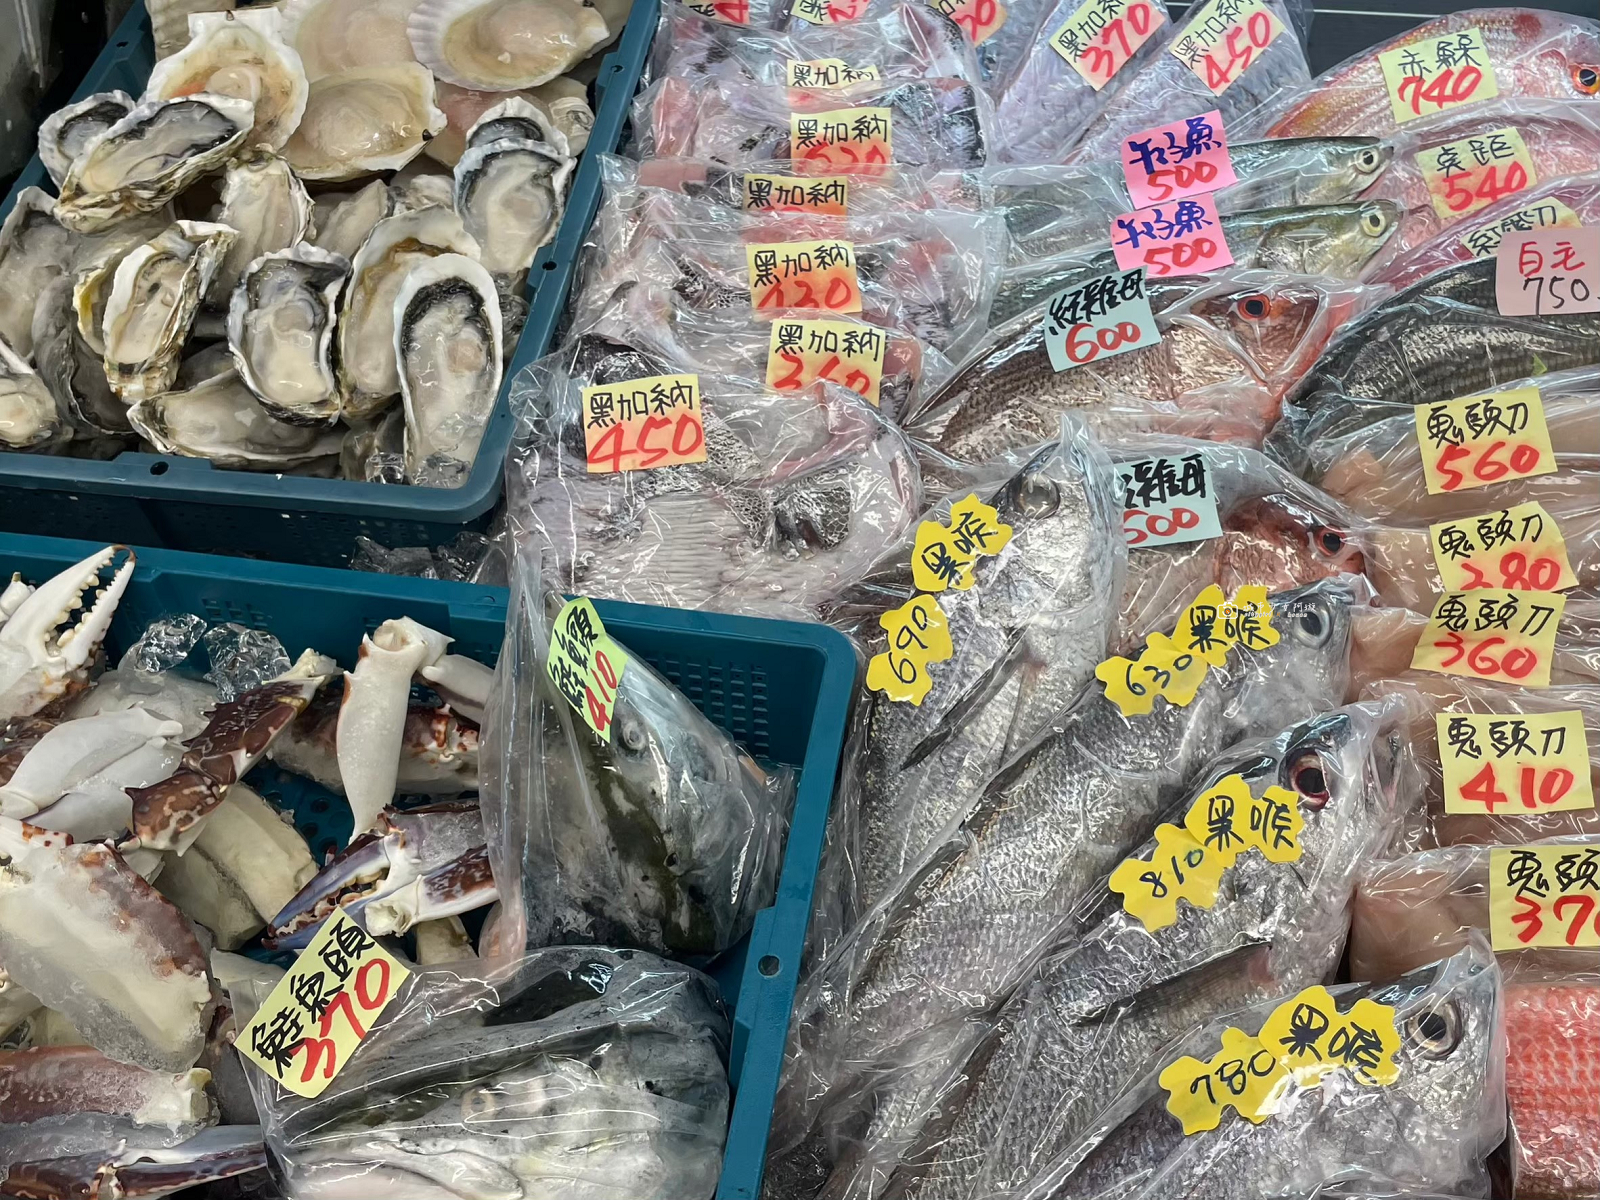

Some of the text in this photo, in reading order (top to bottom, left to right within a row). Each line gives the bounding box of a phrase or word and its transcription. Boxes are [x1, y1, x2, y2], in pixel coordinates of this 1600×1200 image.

[1081, 3, 1150, 77] 370
[1205, 12, 1270, 89] 450
[793, 64, 874, 87] 黑加納
[1398, 65, 1482, 115] 740
[796, 114, 888, 150] 黑加納
[748, 179, 845, 209] 黑加納
[1148, 161, 1218, 201] 500
[1443, 161, 1527, 211] 540
[754, 243, 850, 287] 黑加納
[1143, 238, 1217, 275] 500
[775, 324, 881, 362] 黑加納
[1065, 322, 1141, 363] 600
[587, 381, 693, 429] 黑加納
[1427, 398, 1530, 449] 鬼頭刀
[587, 413, 702, 472] 450
[1436, 441, 1540, 491] 560
[1438, 510, 1544, 560] 鬼頭刀
[1460, 552, 1560, 591] 280
[1436, 593, 1554, 636] 鬼頭刀
[888, 605, 929, 684] 690
[1434, 632, 1538, 679] 360
[585, 650, 618, 731] 410
[1126, 654, 1193, 696] 630
[1447, 717, 1566, 758] 鬼頭刀
[1459, 761, 1574, 813] 410
[1139, 848, 1204, 898] 810
[1511, 894, 1600, 946] 37
[291, 958, 390, 1082] 370
[1190, 1050, 1276, 1105] 780
